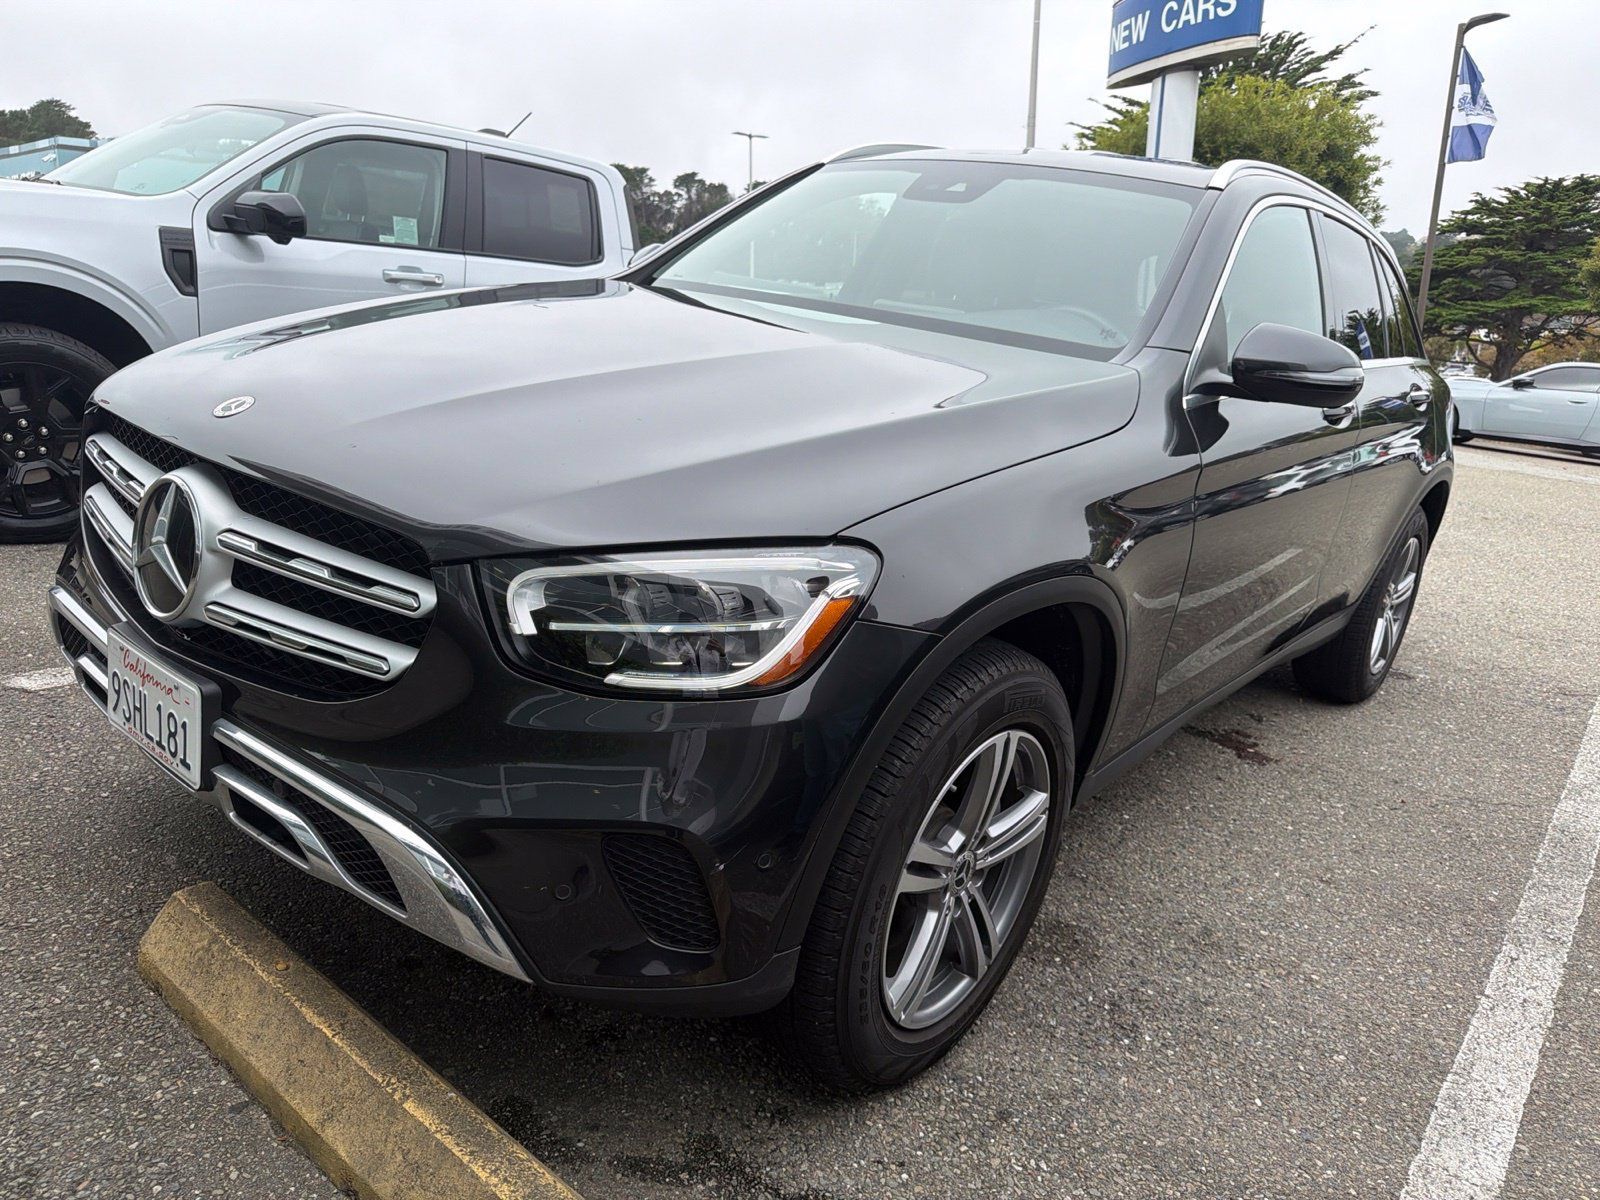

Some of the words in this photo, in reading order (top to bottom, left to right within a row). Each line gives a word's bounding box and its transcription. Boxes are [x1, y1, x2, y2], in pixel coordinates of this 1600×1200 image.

[1110, 10, 1150, 55] NEW
[1161, 0, 1238, 33] CARS
[122, 649, 180, 705] California
[112, 671, 191, 771] 9SHL181
[128, 727, 174, 766] dmv.ca.gov
